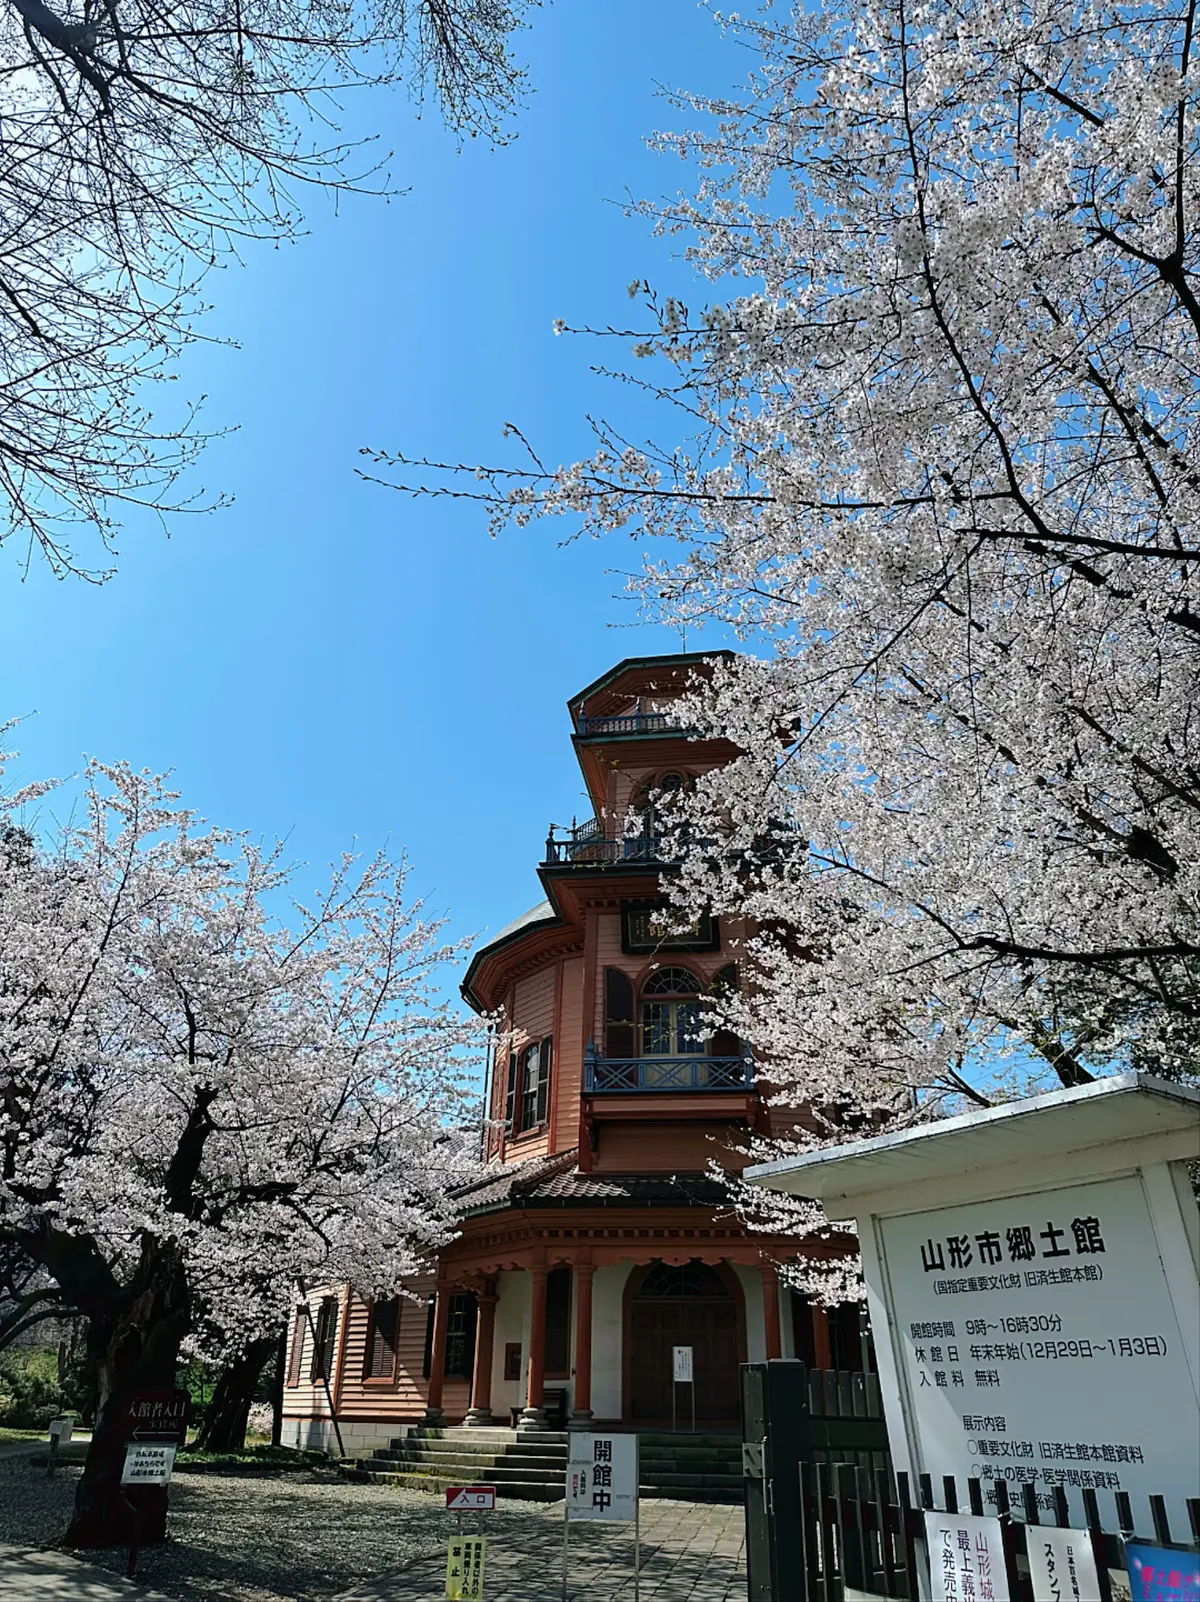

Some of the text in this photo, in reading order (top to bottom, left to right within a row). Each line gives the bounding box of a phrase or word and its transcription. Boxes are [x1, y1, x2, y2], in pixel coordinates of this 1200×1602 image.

[920, 1216, 1106, 1273] 山形市郷土館
[910, 1321, 956, 1339] 開館時間
[974, 1369, 1001, 1388] 無料
[962, 1415, 1007, 1433] 展示内容
[1039, 1441, 1145, 1465] 旧済生館本館資料
[592, 1440, 612, 1512] 開館中
[460, 1494, 486, 1504] 入口
[451, 1546, 461, 1577] 禁止
